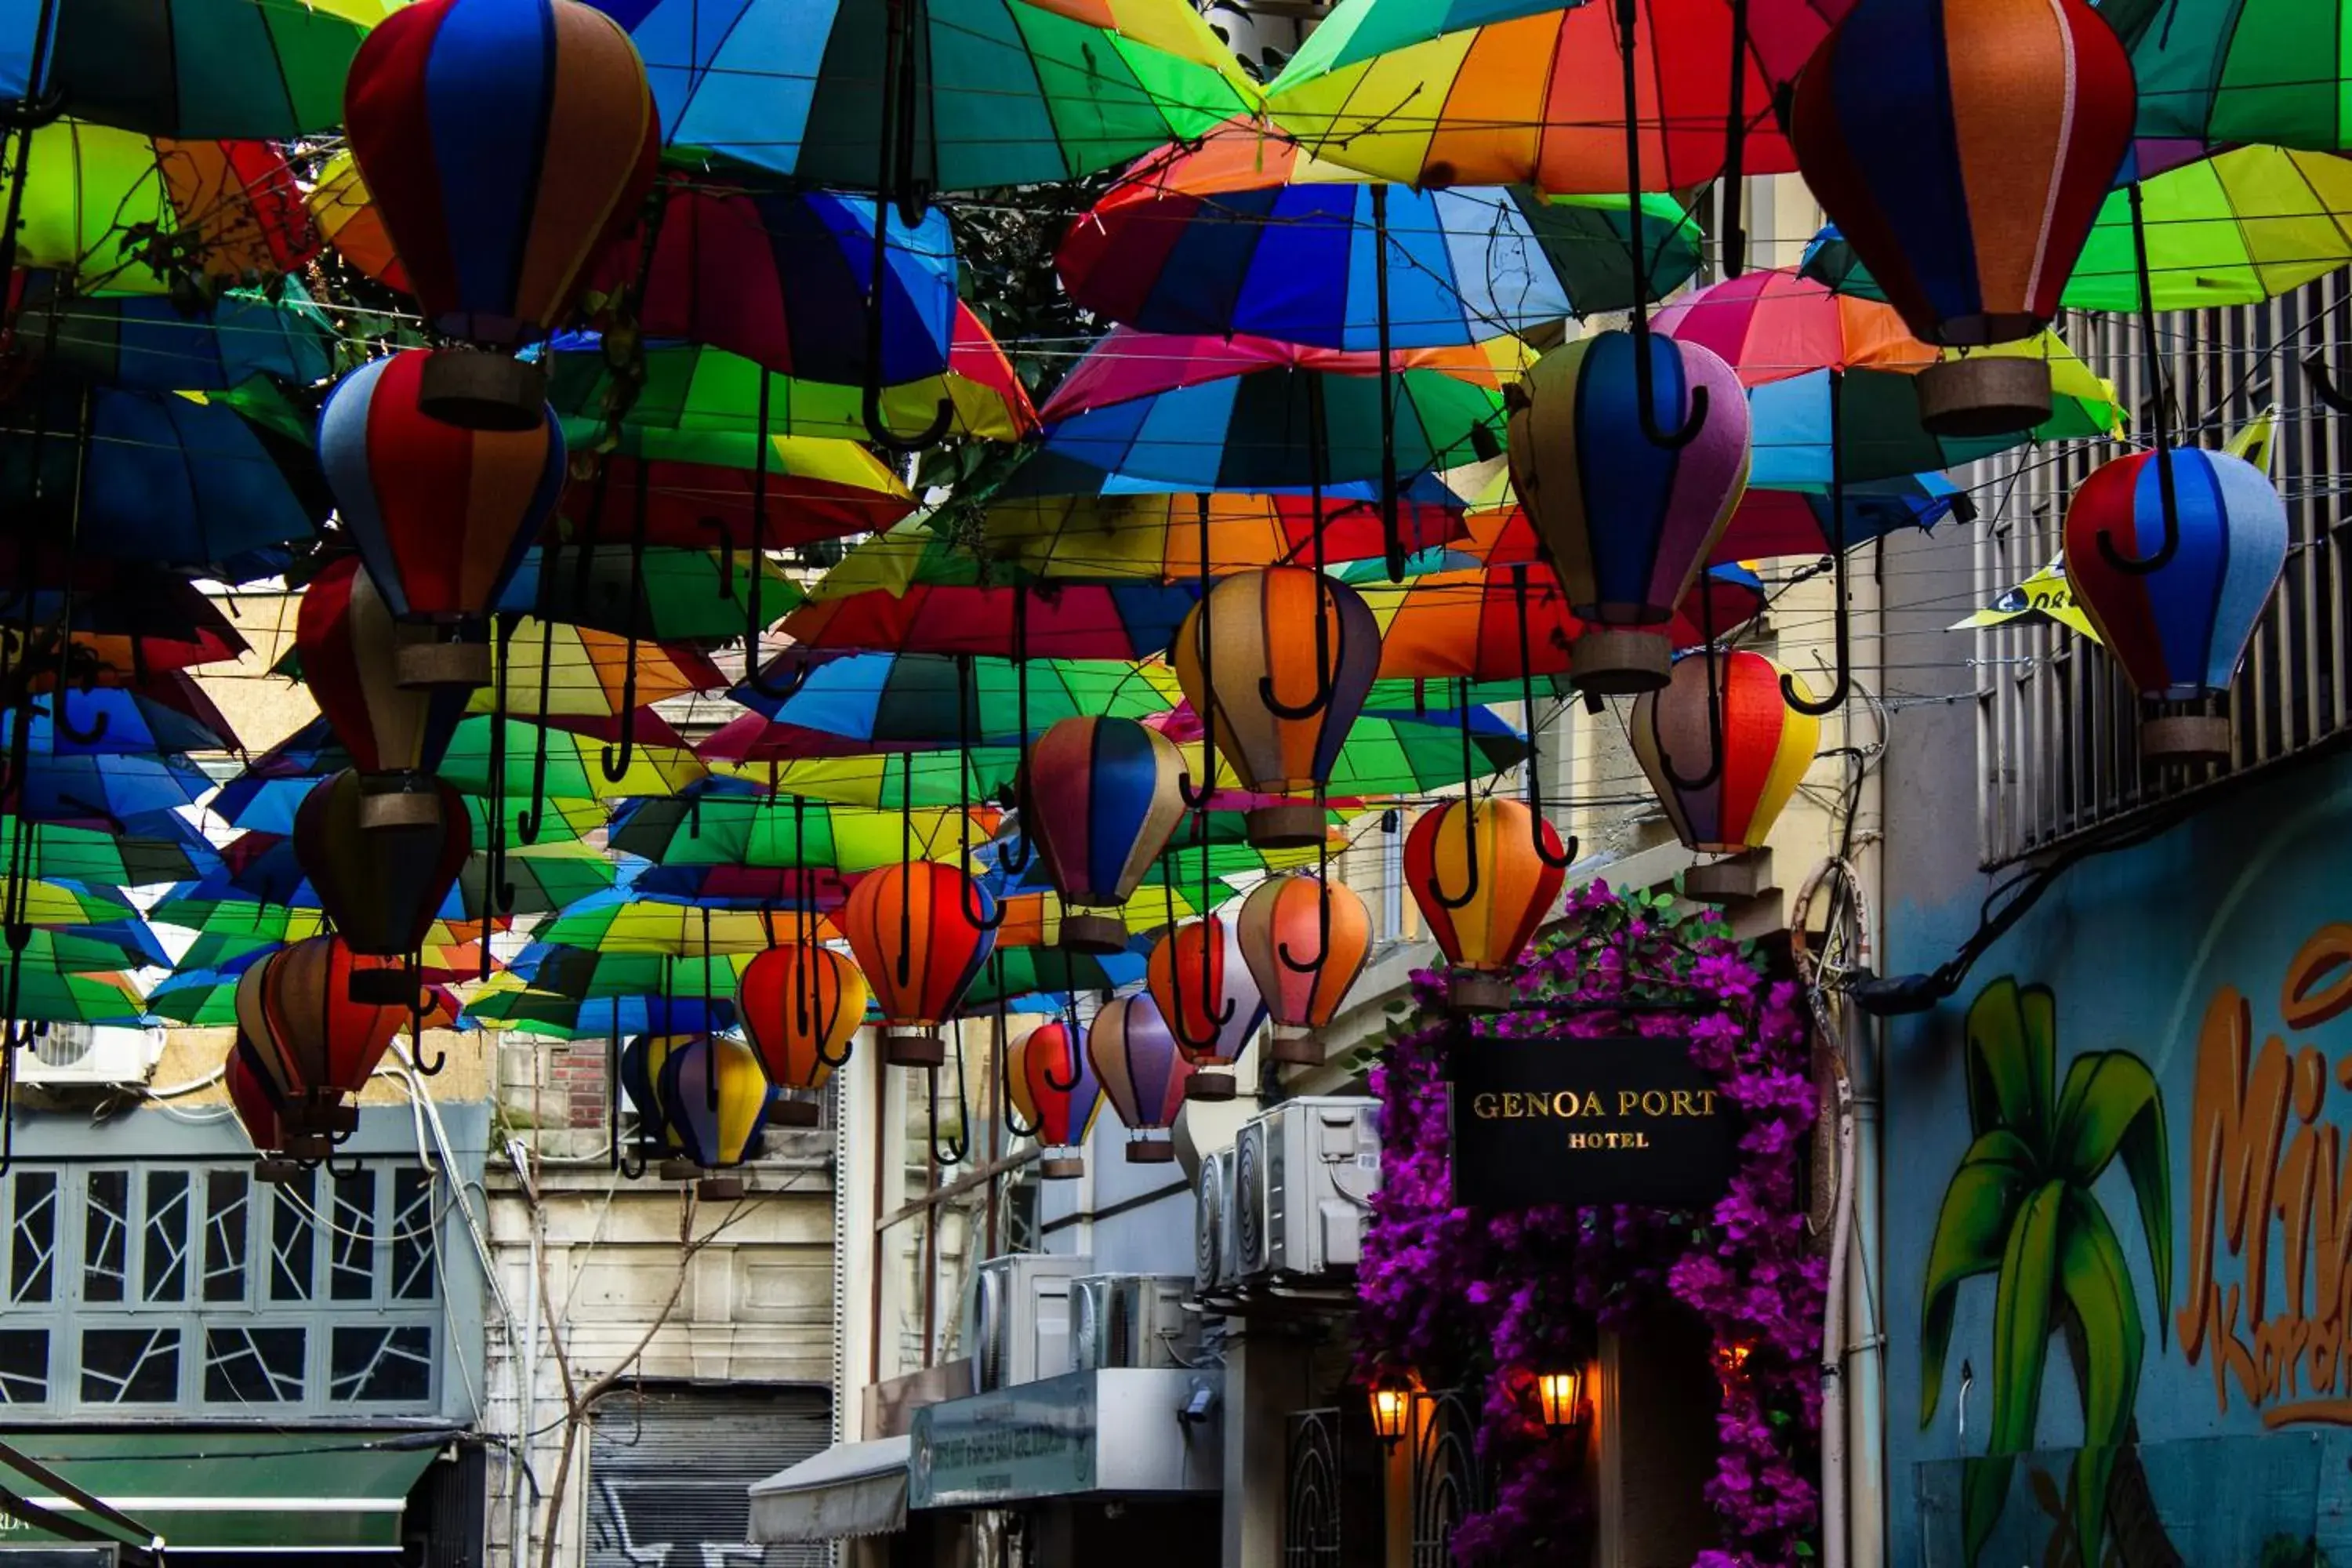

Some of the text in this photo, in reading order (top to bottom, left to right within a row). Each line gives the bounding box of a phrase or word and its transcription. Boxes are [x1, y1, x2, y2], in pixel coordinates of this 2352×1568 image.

[1473, 1090, 1719, 1119] GENOA PORT
[1568, 1133, 1650, 1149] HOTEL
